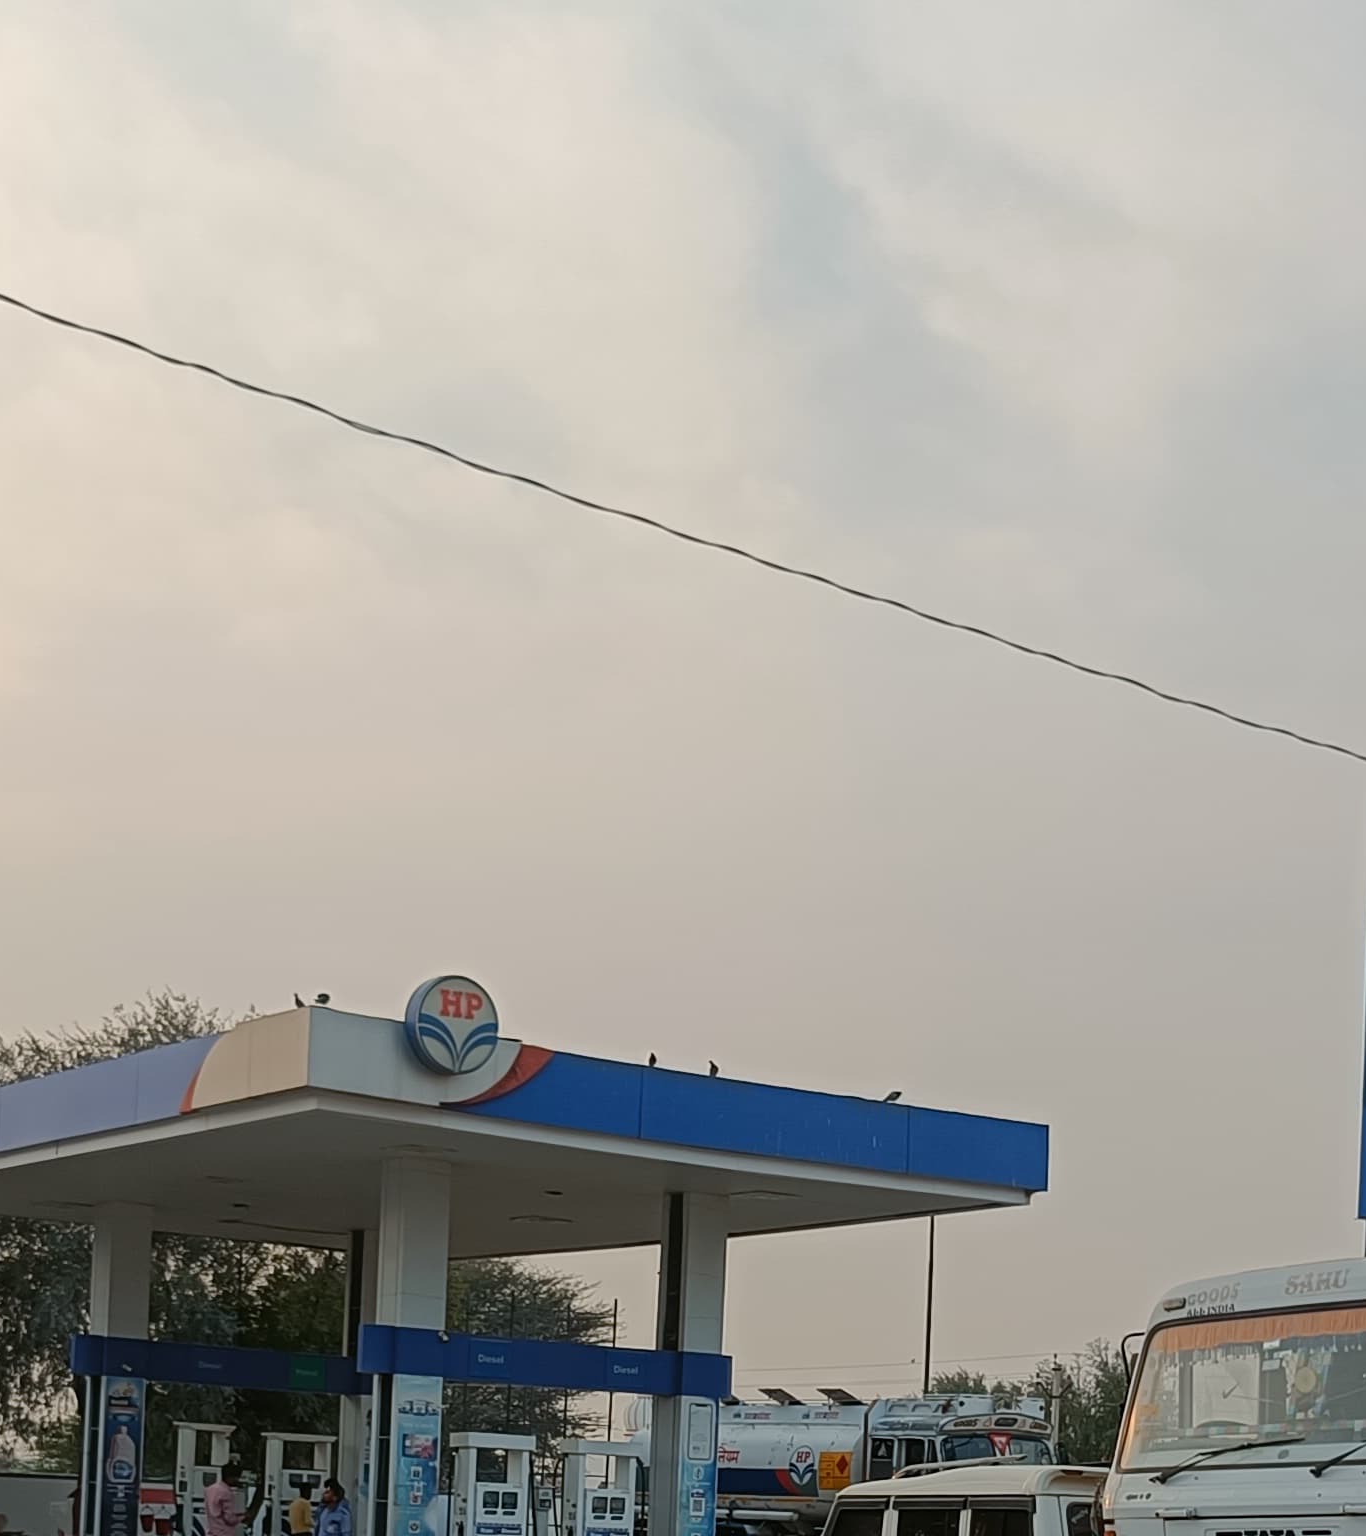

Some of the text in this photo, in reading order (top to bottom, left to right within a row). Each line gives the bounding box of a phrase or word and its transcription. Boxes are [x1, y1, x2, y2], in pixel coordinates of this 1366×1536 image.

[439, 988, 483, 1020] HP
[1187, 1282, 1241, 1307] GOODS
[1284, 1269, 1350, 1296] SAHU
[1207, 1303, 1236, 1315] INDIA
[477, 1353, 505, 1366] Diesel
[612, 1364, 639, 1376] Diesel
[796, 1451, 811, 1464] HP
